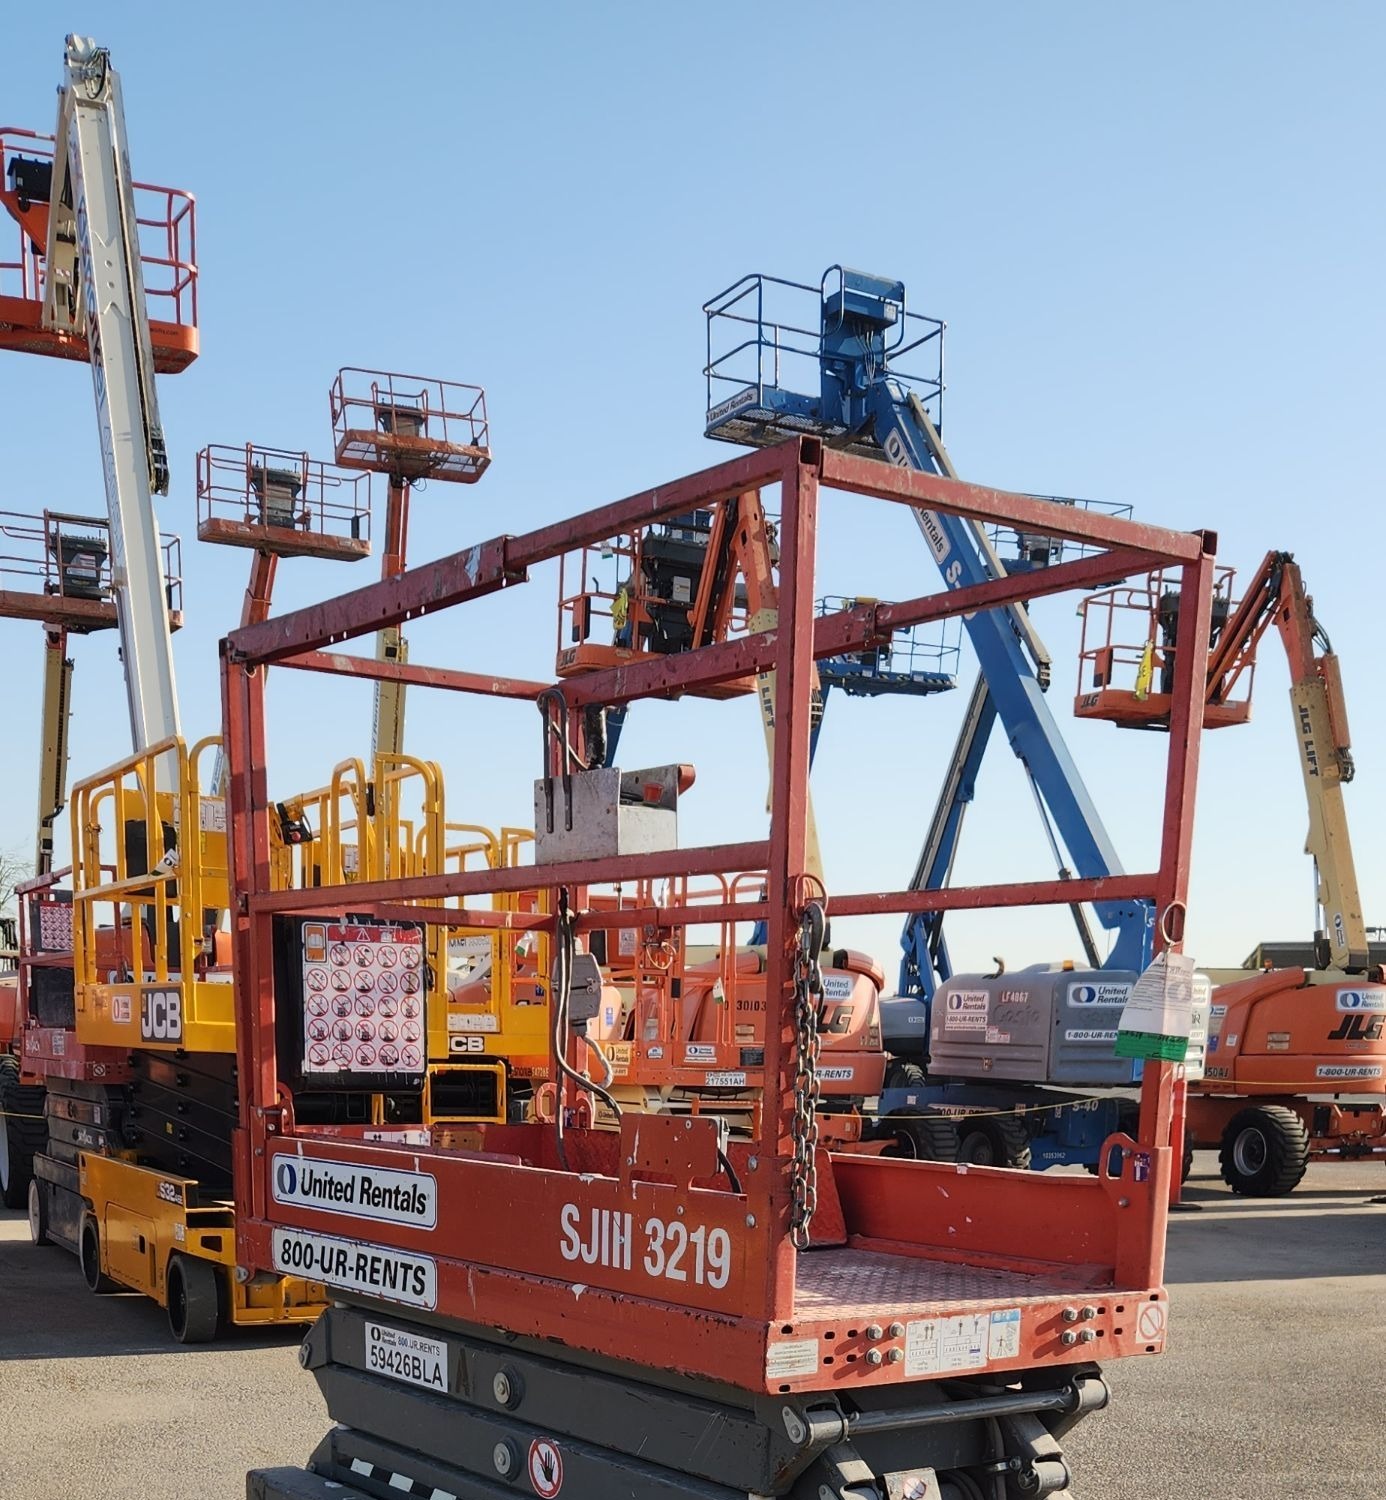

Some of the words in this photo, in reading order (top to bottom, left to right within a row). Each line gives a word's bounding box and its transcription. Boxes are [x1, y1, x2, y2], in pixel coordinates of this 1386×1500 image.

[710, 403, 730, 421] United
[730, 392, 753, 409] Rentals
[917, 506, 945, 553] entals
[560, 650, 575, 667] JLG
[761, 686, 775, 728] LIFT
[1080, 694, 1099, 708] JLG
[1298, 704, 1312, 734] JLG
[1303, 740, 1319, 777] LIFT
[823, 978, 849, 988] United
[825, 987, 851, 997] Rentals
[962, 993, 985, 1002] United
[1098, 986, 1128, 995] United
[1361, 991, 1385, 1001] United
[962, 1002, 986, 1010] Rentals
[1360, 1000, 1385, 1008] Rentals
[141, 992, 182, 1039] JCB
[816, 1005, 854, 1034] LG
[1327, 1014, 1386, 1040] JLG
[1067, 1031, 1118, 1039] 1-800-UR-REN
[450, 1036, 484, 1051] CB
[814, 1068, 852, 1080] R-RENTS
[1318, 1066, 1381, 1076] 1-800-UR-RENTS
[1072, 1099, 1099, 1112] S-40
[301, 1168, 355, 1204] United
[359, 1176, 427, 1216] Rentals
[643, 1217, 731, 1290] 3219
[280, 1238, 427, 1297] 800-UR-RENTS
[382, 1329, 396, 1339] United
[382, 1337, 397, 1347] Rentals
[370, 1344, 444, 1388] 59426BLA
